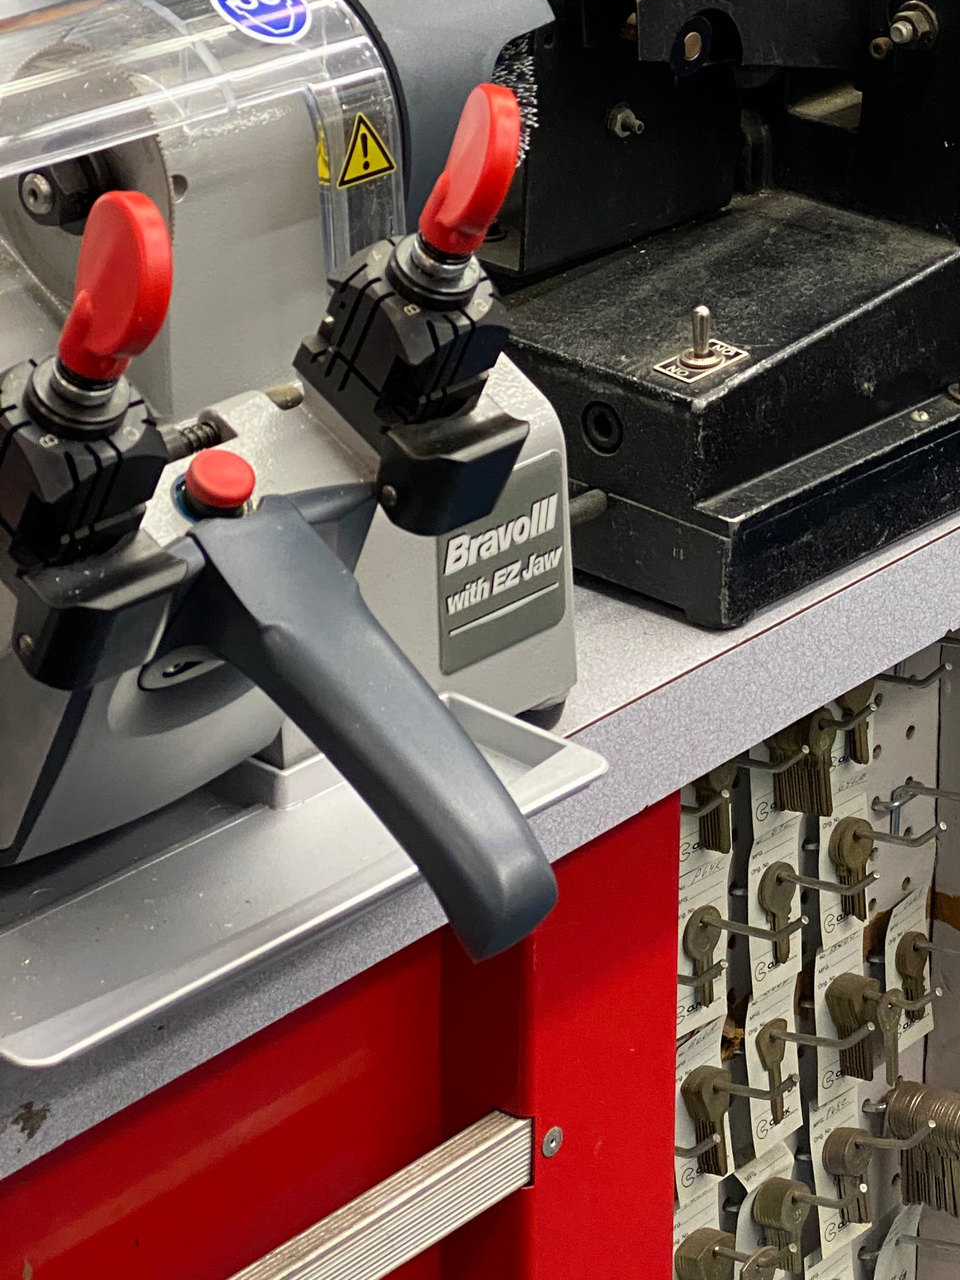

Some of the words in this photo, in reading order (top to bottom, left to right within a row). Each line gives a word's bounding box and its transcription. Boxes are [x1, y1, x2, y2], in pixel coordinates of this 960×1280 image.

[446, 576, 492, 615] with
[491, 559, 522, 596] EZ
[521, 546, 563, 581] Jaw
